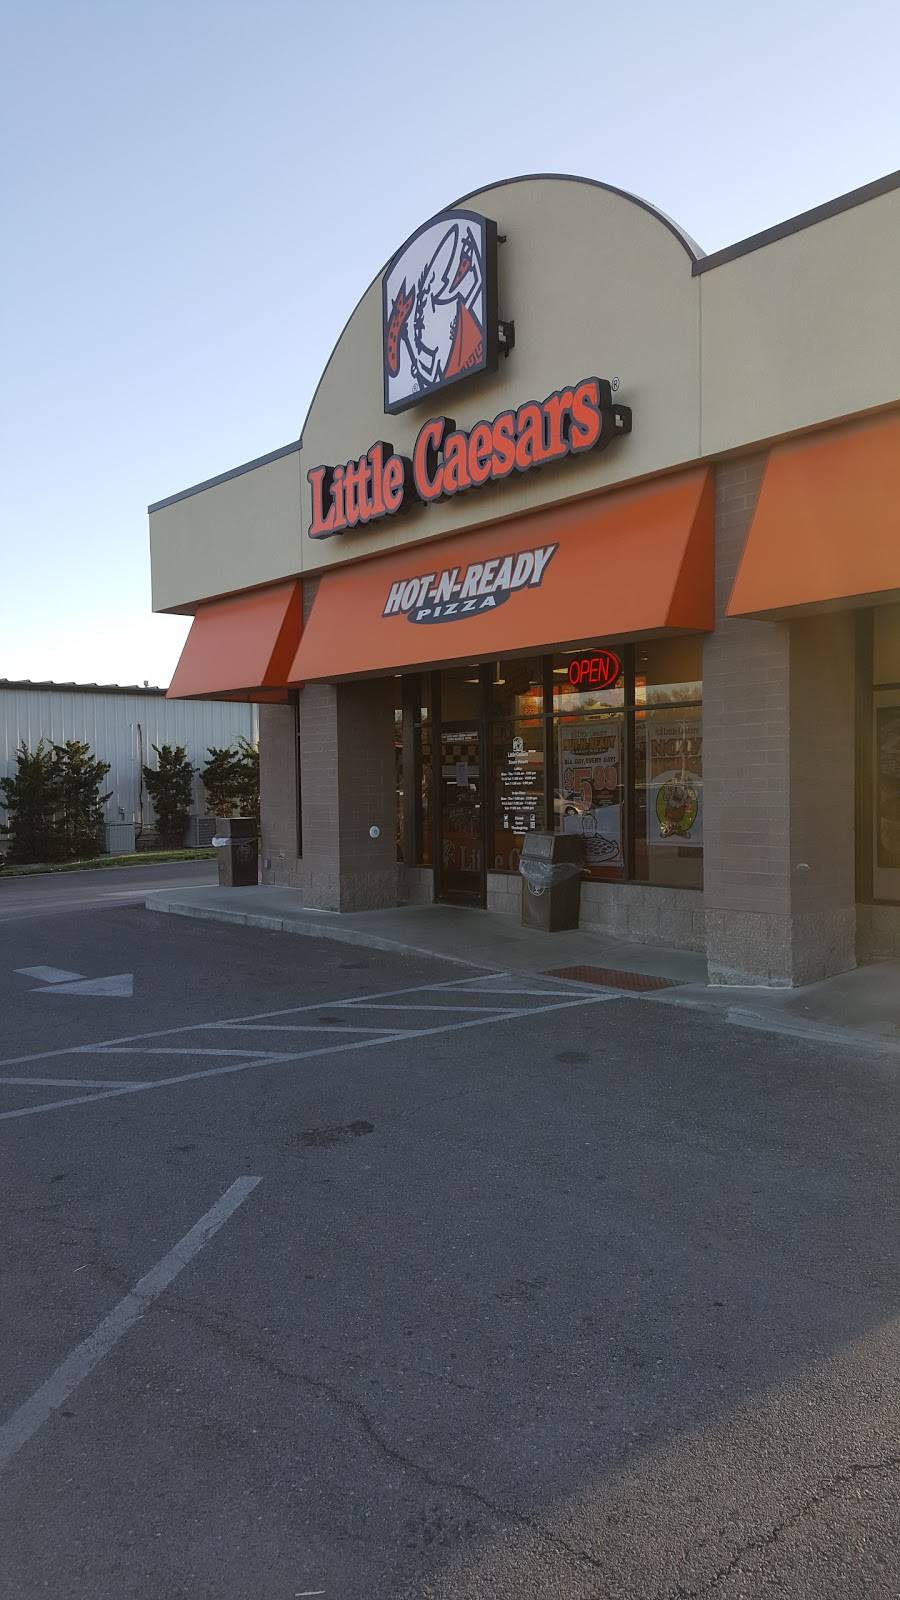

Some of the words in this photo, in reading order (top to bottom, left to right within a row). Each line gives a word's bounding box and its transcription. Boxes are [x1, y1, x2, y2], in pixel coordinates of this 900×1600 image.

[308, 440, 405, 538] Little
[414, 377, 602, 501] Caesars
[383, 544, 557, 616] HOT-N-READY
[416, 595, 496, 621] PIZZA
[569, 656, 609, 685] OPEN
